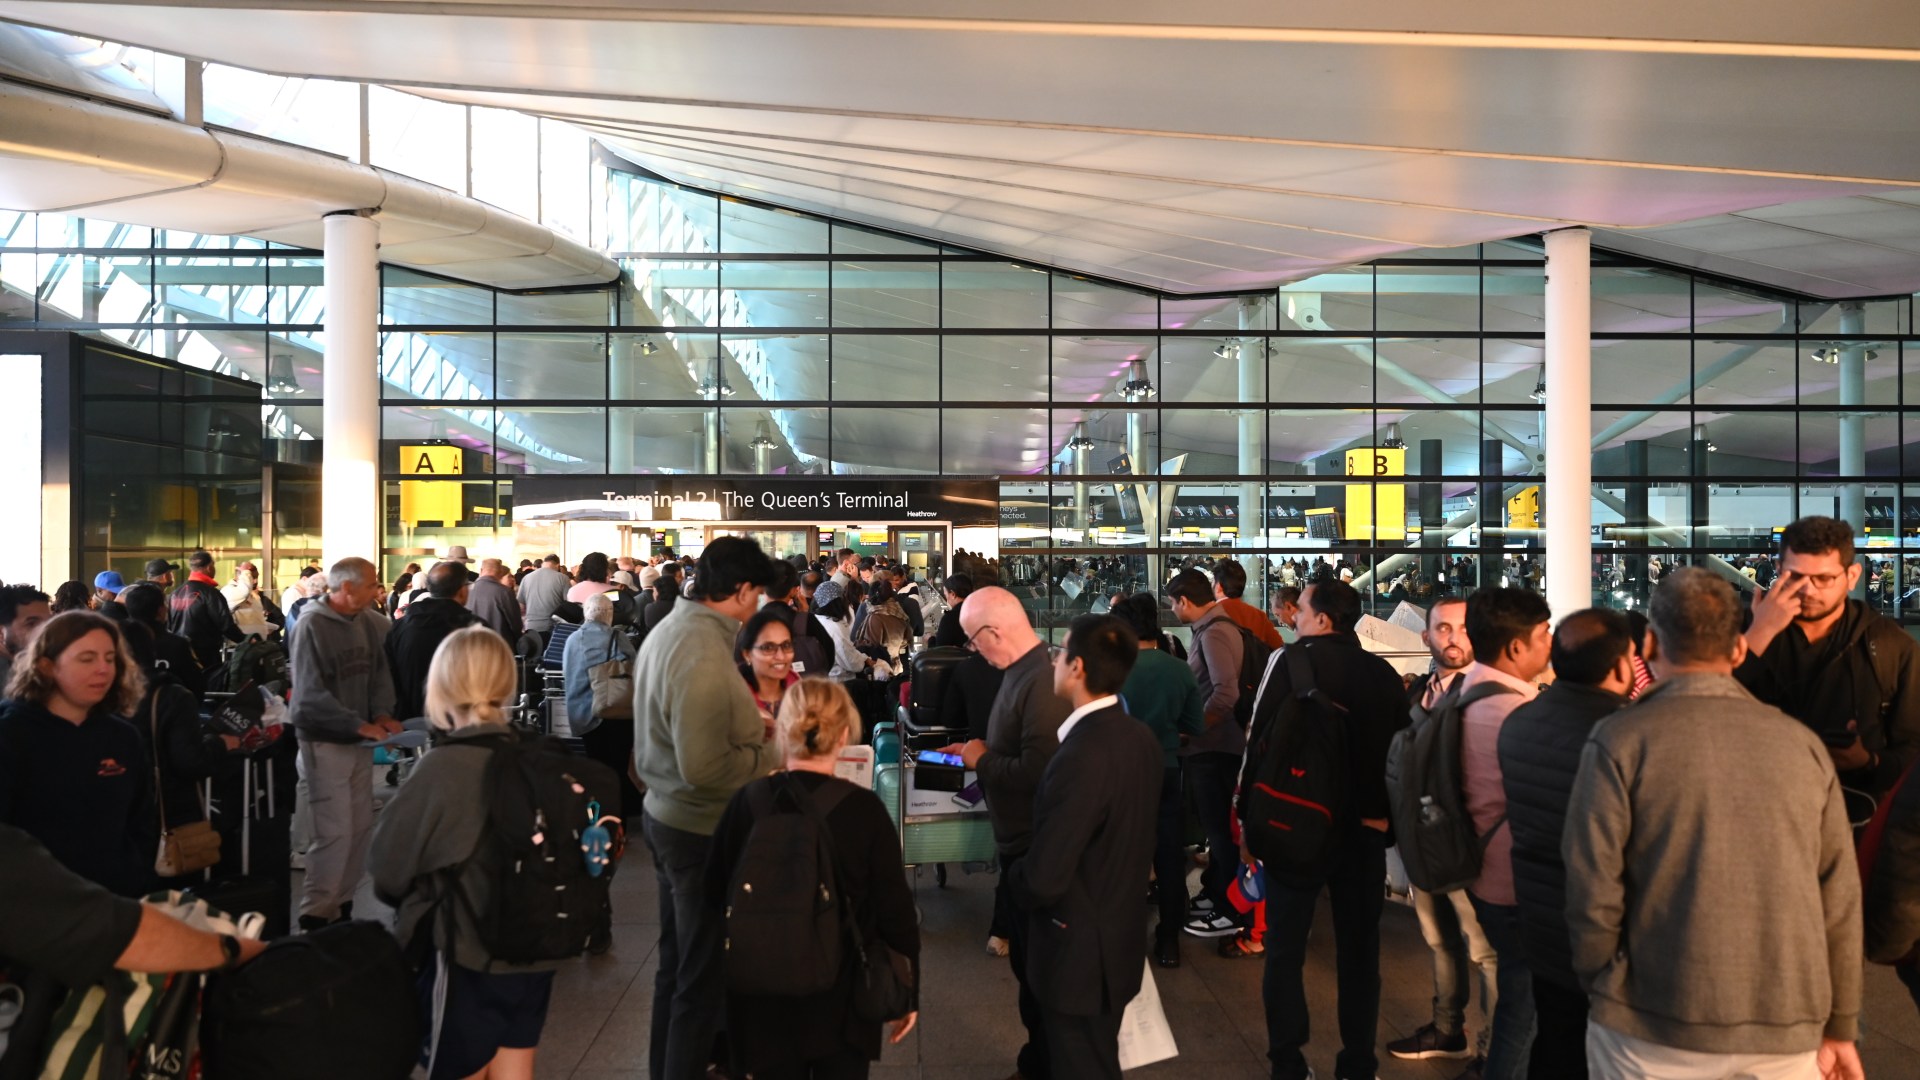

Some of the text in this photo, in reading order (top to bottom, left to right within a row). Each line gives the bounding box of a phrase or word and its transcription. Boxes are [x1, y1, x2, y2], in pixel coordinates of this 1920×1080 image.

[415, 453, 434, 473] A
[453, 454, 459, 474] A
[1348, 456, 1354, 475] B
[1374, 455, 1388, 475] B
[722, 491, 754, 508] The
[836, 491, 908, 508] Terminal
[222, 707, 251, 729] M&S
